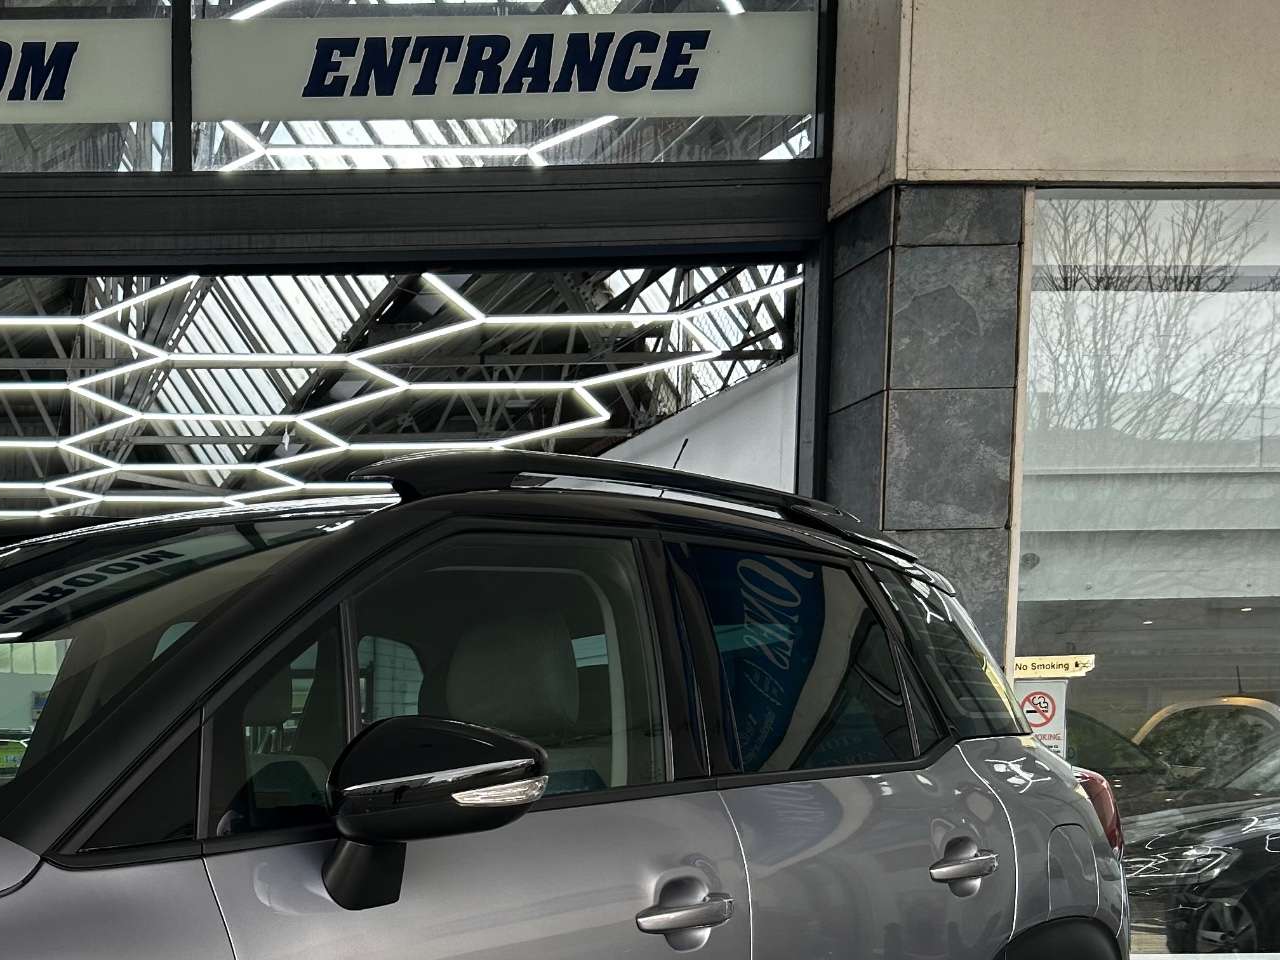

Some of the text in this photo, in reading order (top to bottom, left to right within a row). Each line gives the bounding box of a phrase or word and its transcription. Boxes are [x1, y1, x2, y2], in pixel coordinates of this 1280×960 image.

[301, 30, 711, 98] ENTRANCE
[1015, 661, 1070, 671] No Smoking
